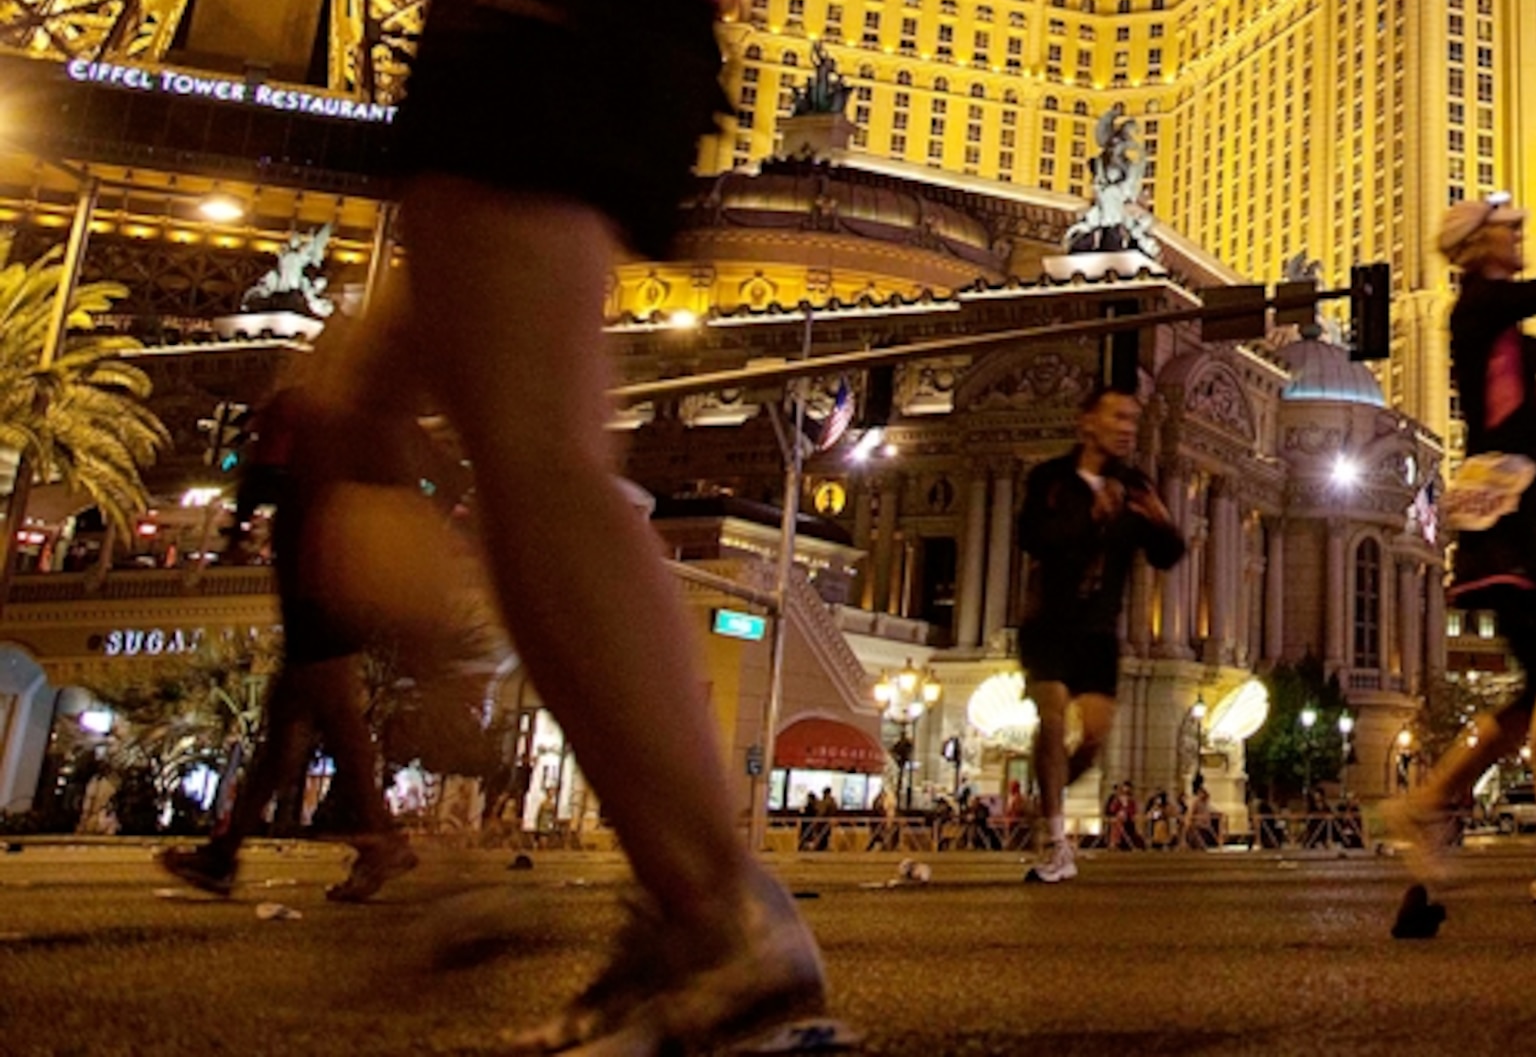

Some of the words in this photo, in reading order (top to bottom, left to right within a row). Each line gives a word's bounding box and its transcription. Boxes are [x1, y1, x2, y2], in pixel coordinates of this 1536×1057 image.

[67, 58, 153, 90] EIFFEL
[160, 69, 246, 103] TOWER
[254, 83, 398, 124] RESTAURANT
